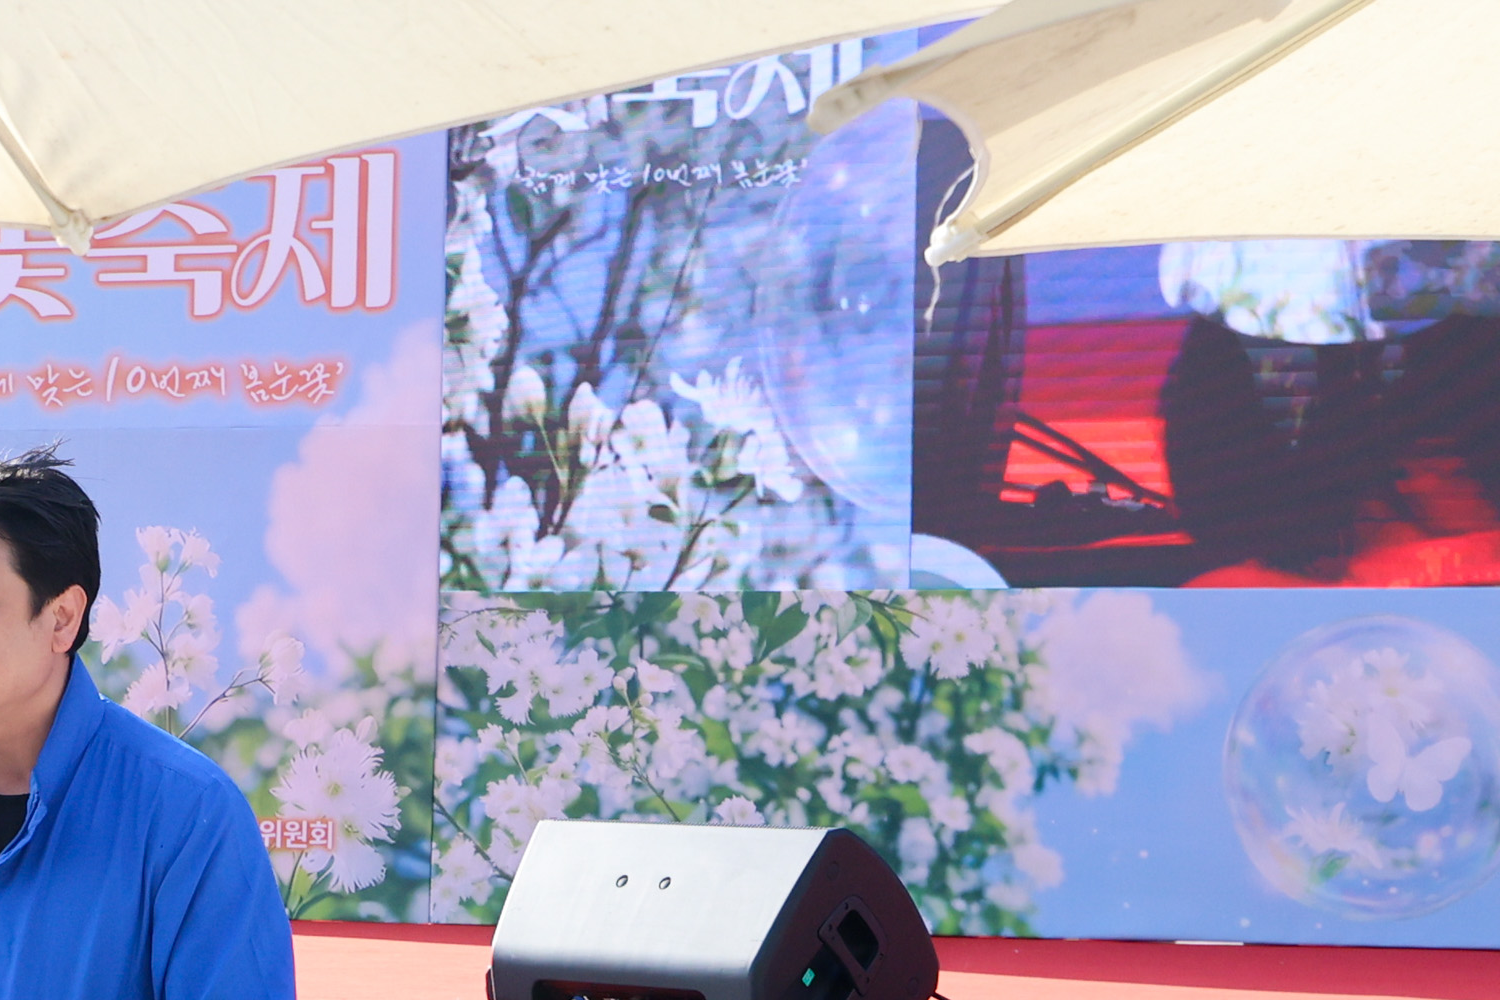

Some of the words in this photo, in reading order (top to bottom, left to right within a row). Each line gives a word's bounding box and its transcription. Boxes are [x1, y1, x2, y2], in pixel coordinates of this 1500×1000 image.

[642, 162, 722, 187] 10번째
[26, 363, 93, 407] 맞는
[104, 356, 226, 402] 10번째
